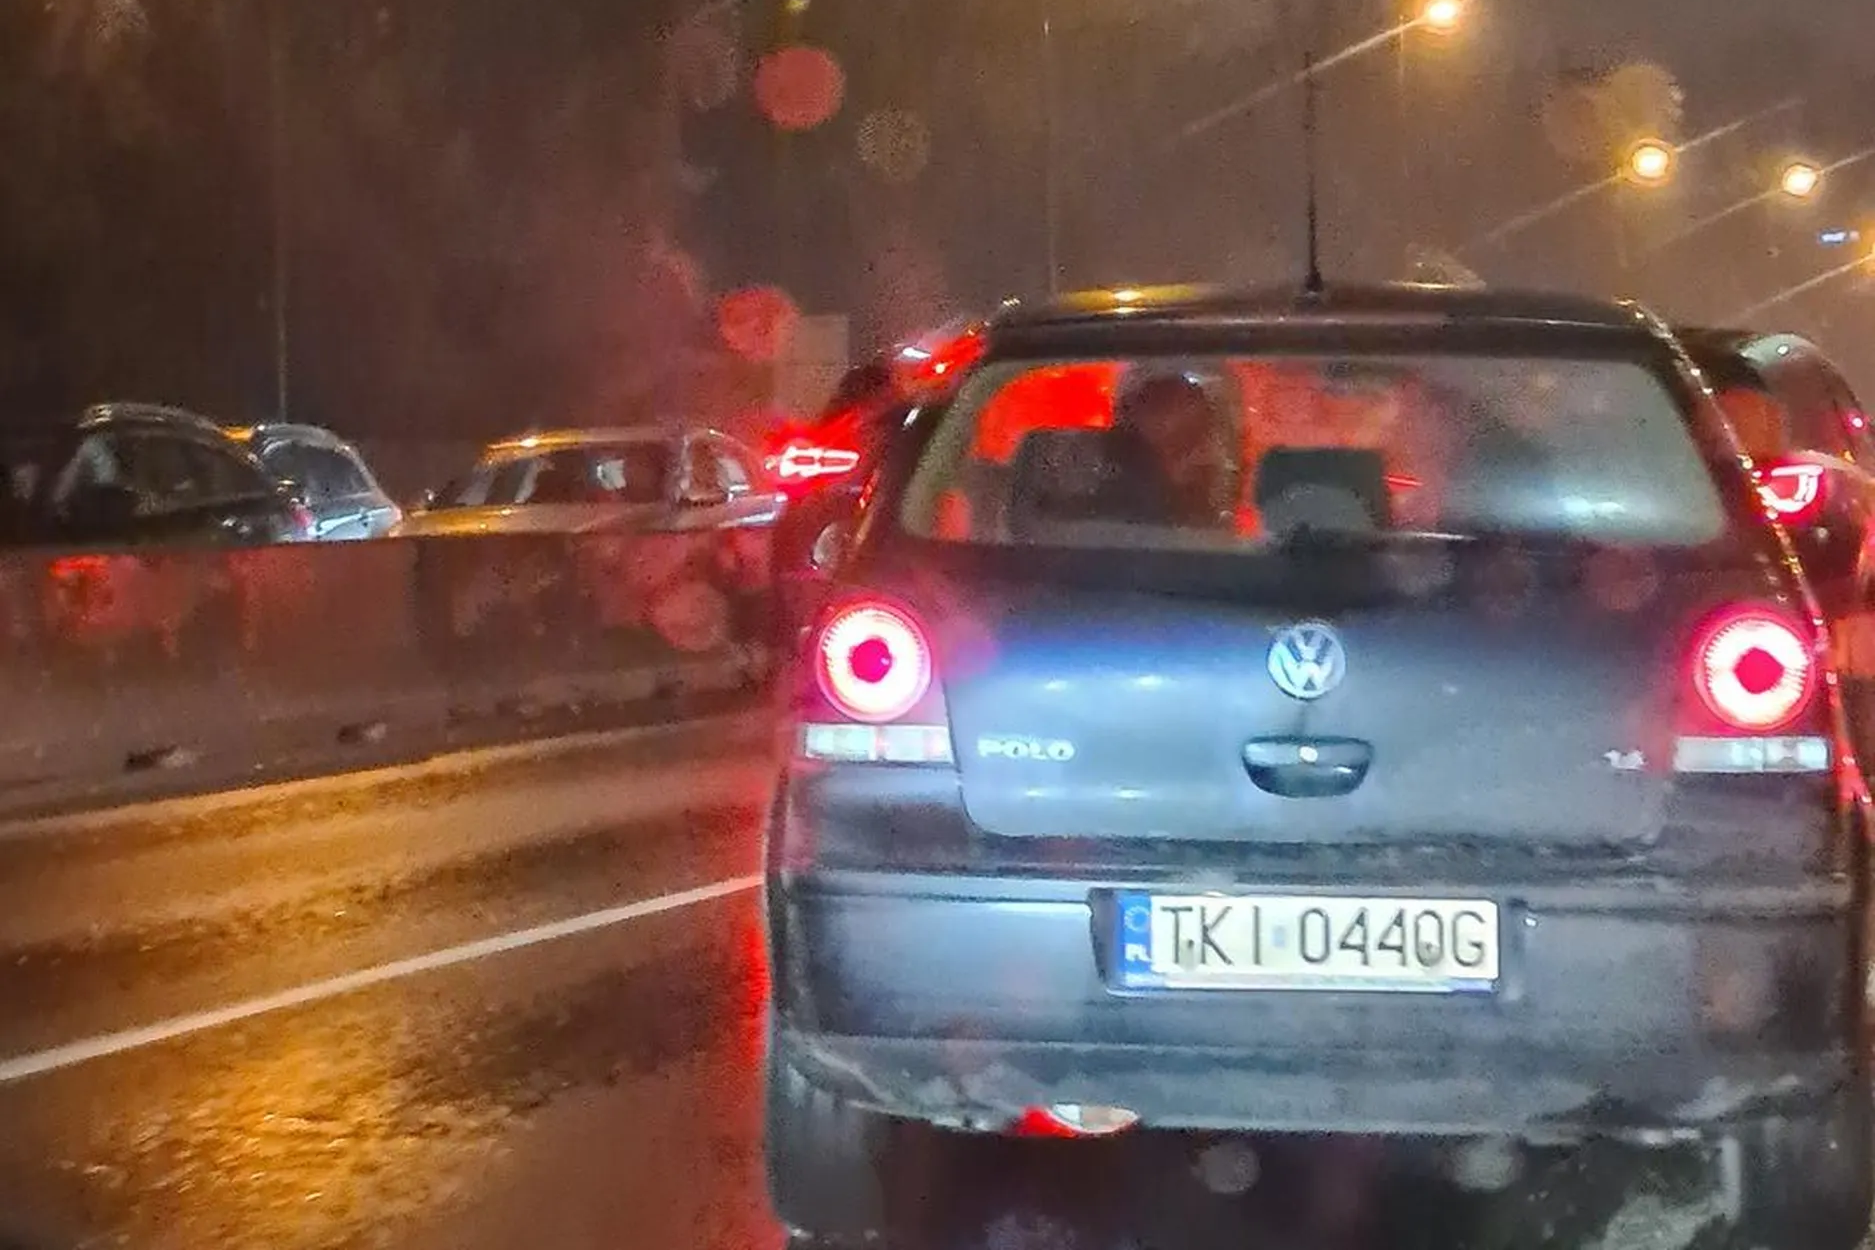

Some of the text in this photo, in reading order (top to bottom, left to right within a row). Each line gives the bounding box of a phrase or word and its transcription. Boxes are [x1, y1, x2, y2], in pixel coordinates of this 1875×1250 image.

[1270, 625, 1344, 696] VW
[1160, 904, 1486, 968] TKI 0440G
